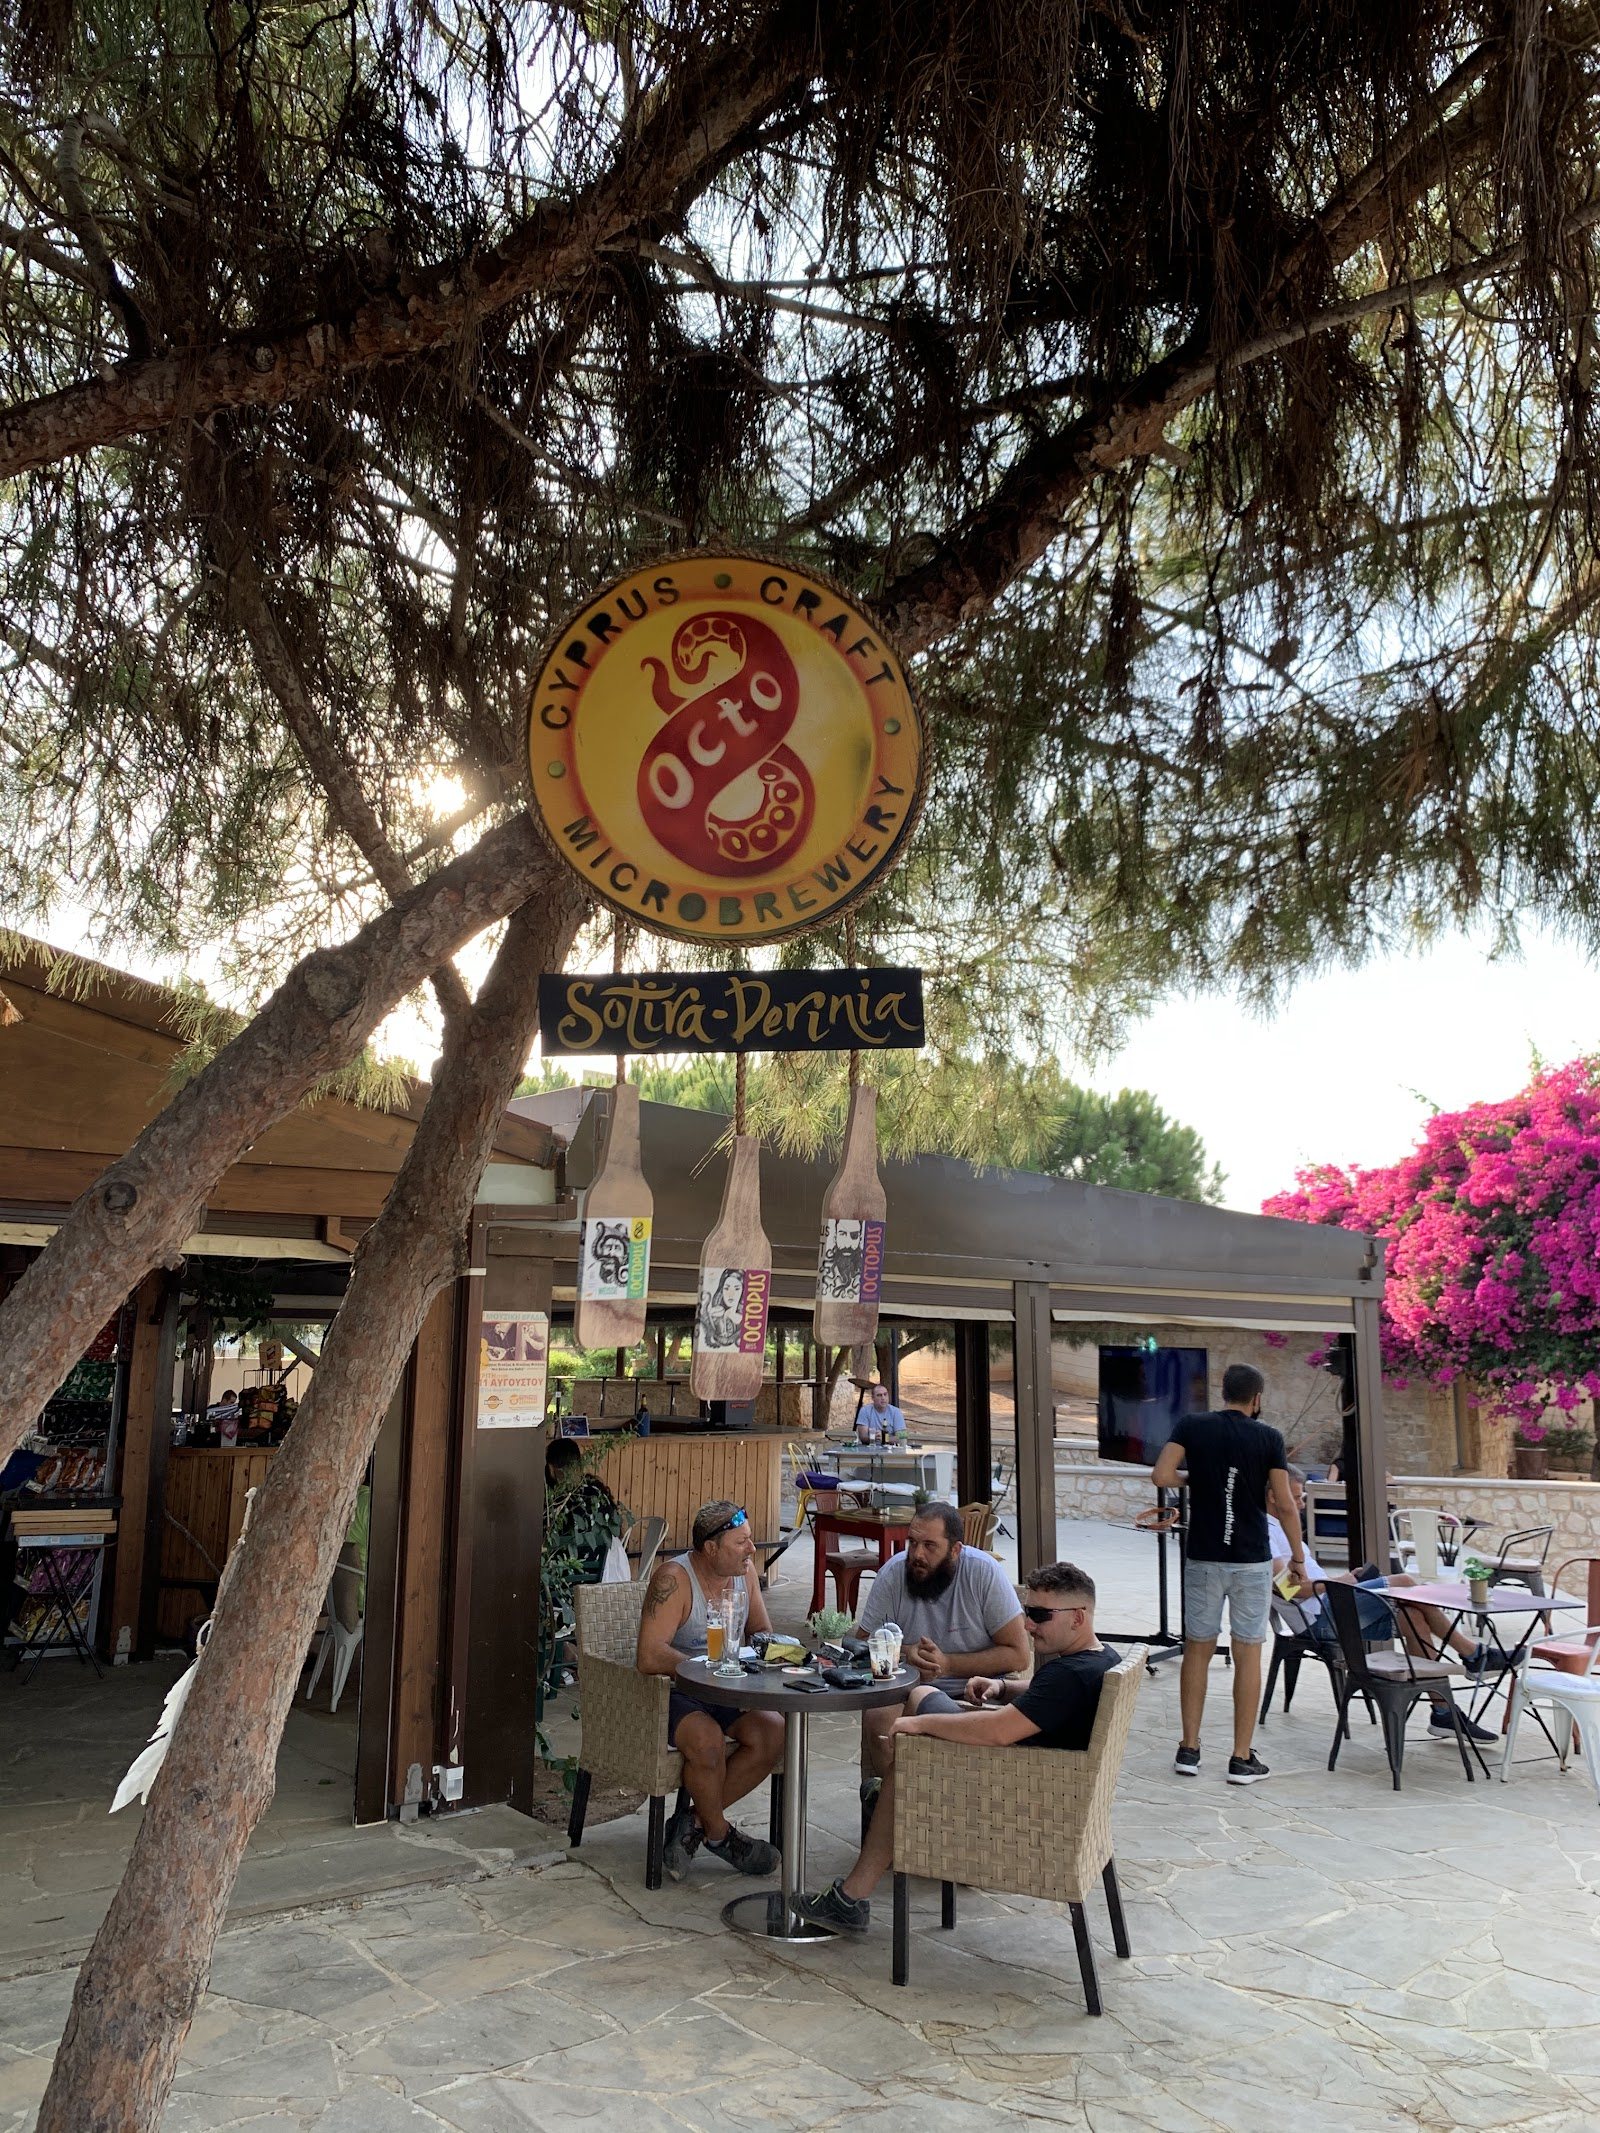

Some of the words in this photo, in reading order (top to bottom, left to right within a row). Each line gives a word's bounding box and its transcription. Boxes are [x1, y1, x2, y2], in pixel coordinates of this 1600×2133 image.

[541, 576, 681, 731] CYPRUS
[759, 575, 896, 687] CRAFT
[563, 775, 905, 926] MICROBREWERY
[630, 1243, 646, 1292] OCTOPUS
[863, 1226, 883, 1293] OCTOPUS
[743, 1273, 766, 1342] OCTOPUS
[490, 1378, 544, 1387] ΑΥΓΟΥΣΤΟΥ
[1223, 1466, 1239, 1546] #seeyouatthebar
